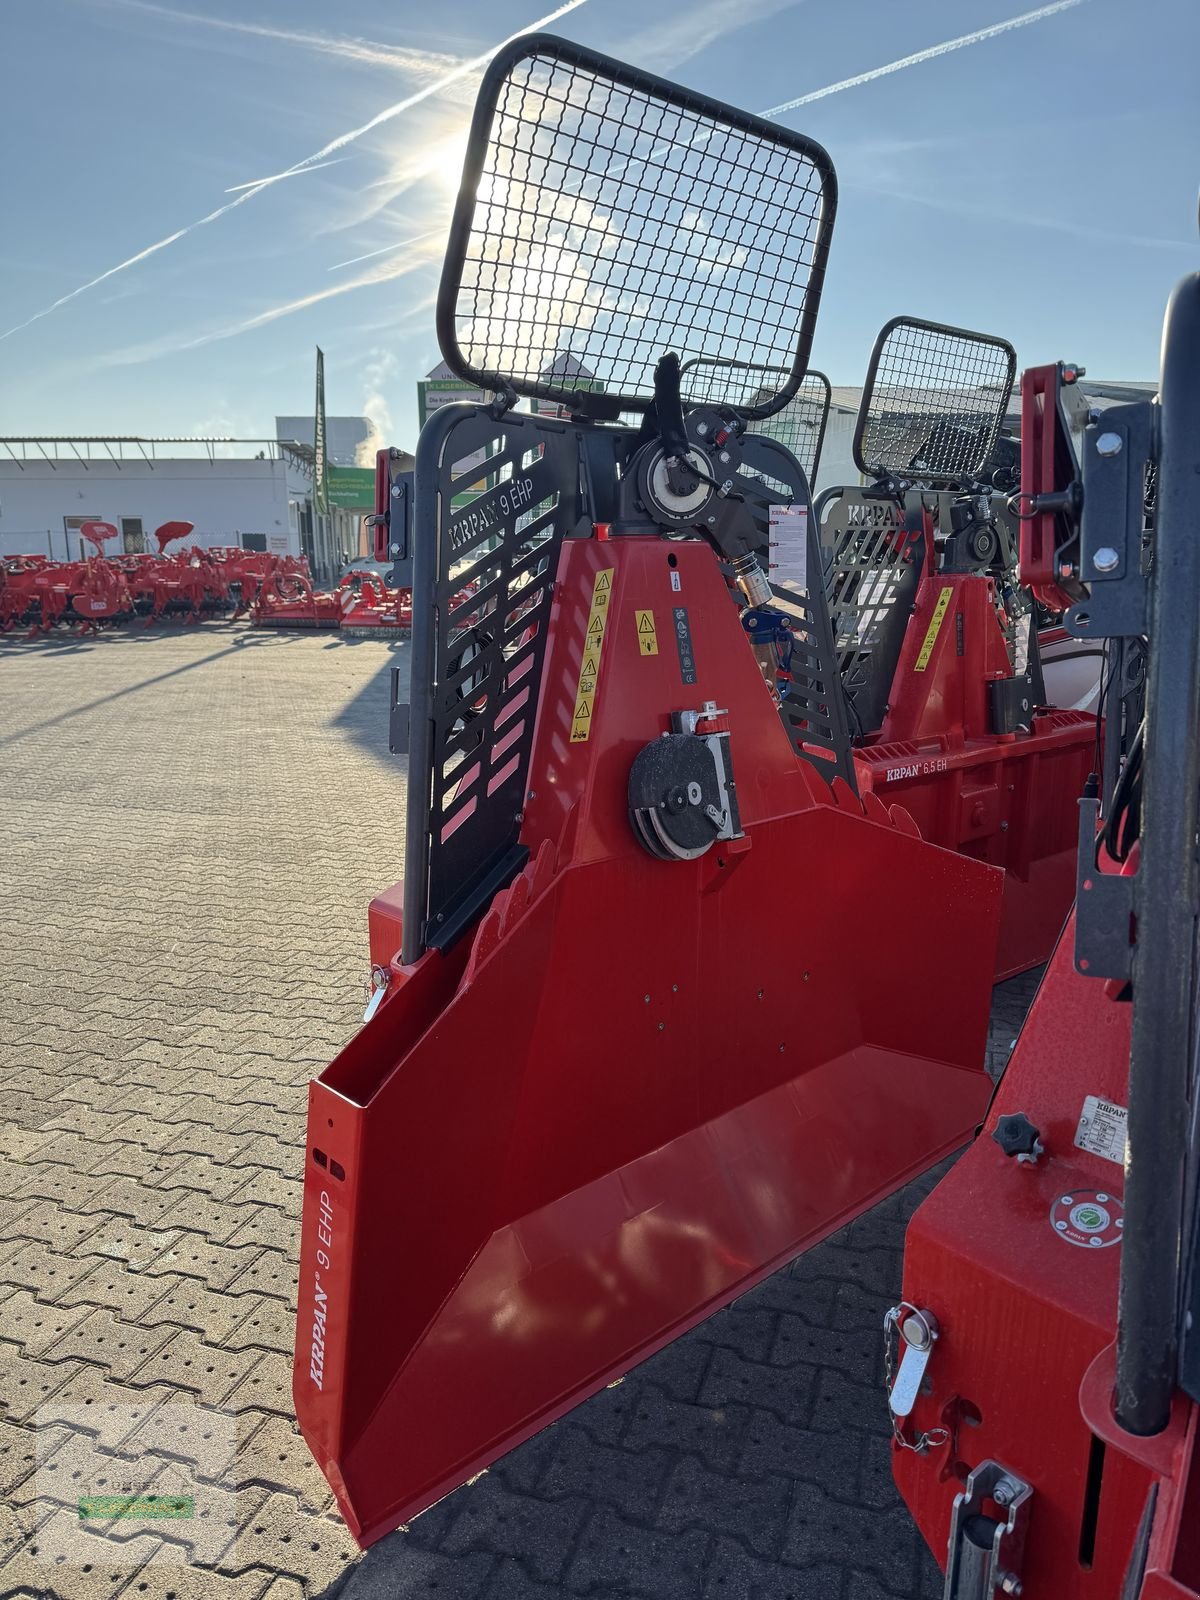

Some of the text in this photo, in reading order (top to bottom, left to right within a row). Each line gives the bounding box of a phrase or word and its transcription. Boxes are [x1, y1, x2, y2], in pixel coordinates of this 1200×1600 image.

[499, 495, 510, 516] 9
[509, 478, 534, 510] EHP
[848, 504, 906, 527] KRPAN
[936, 759, 948, 772] EH
[1096, 1102, 1127, 1119] KRPAN
[318, 1190, 334, 1248] EHP
[316, 1249, 330, 1270] 9
